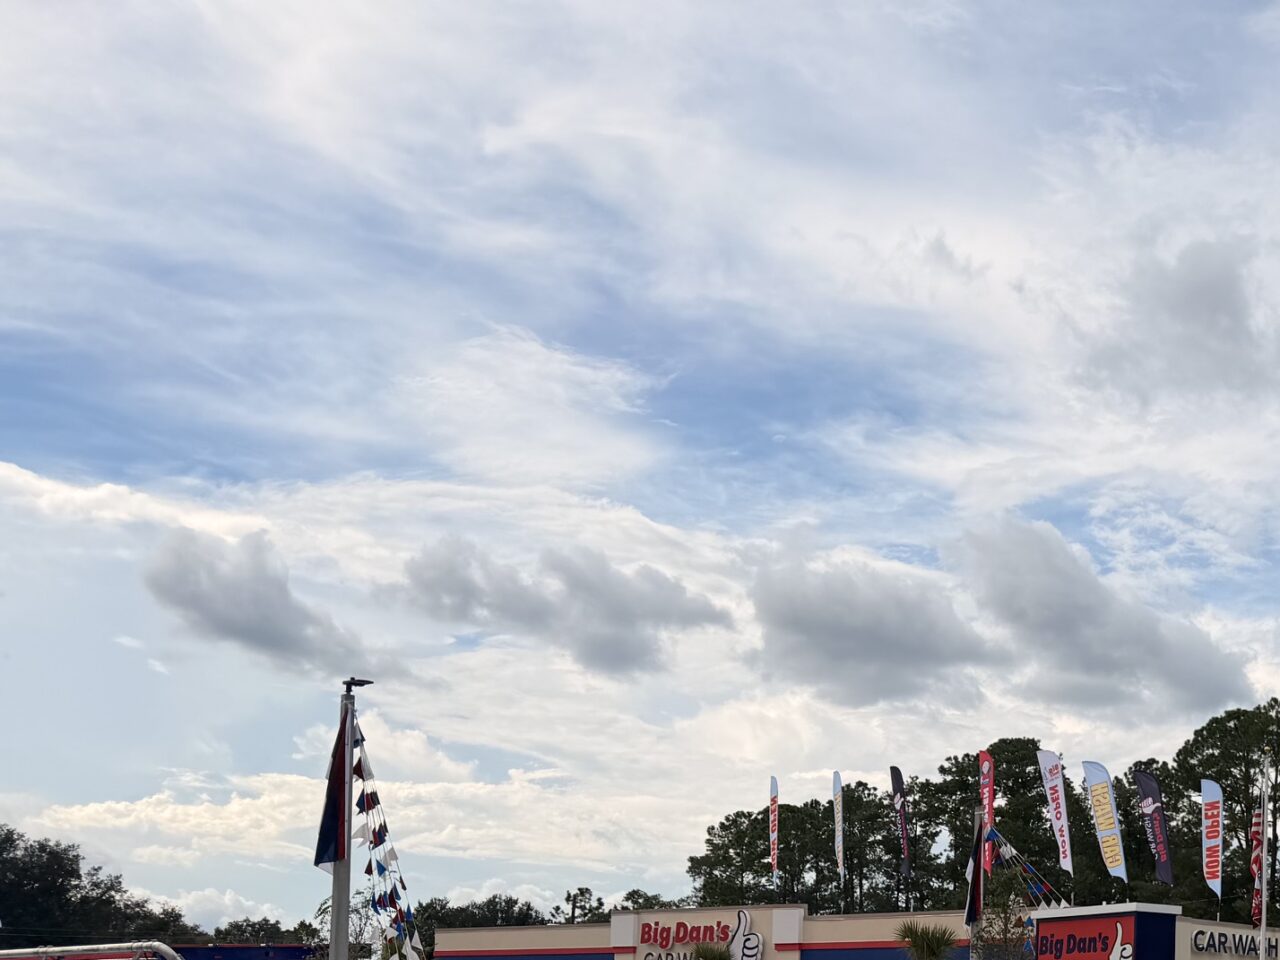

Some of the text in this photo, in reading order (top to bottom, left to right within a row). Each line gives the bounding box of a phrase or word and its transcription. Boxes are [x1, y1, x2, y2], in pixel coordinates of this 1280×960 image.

[640, 921, 732, 949] Big Dan's
[1039, 933, 1109, 959] Big Dan's
[1193, 929, 1228, 954] CAR
